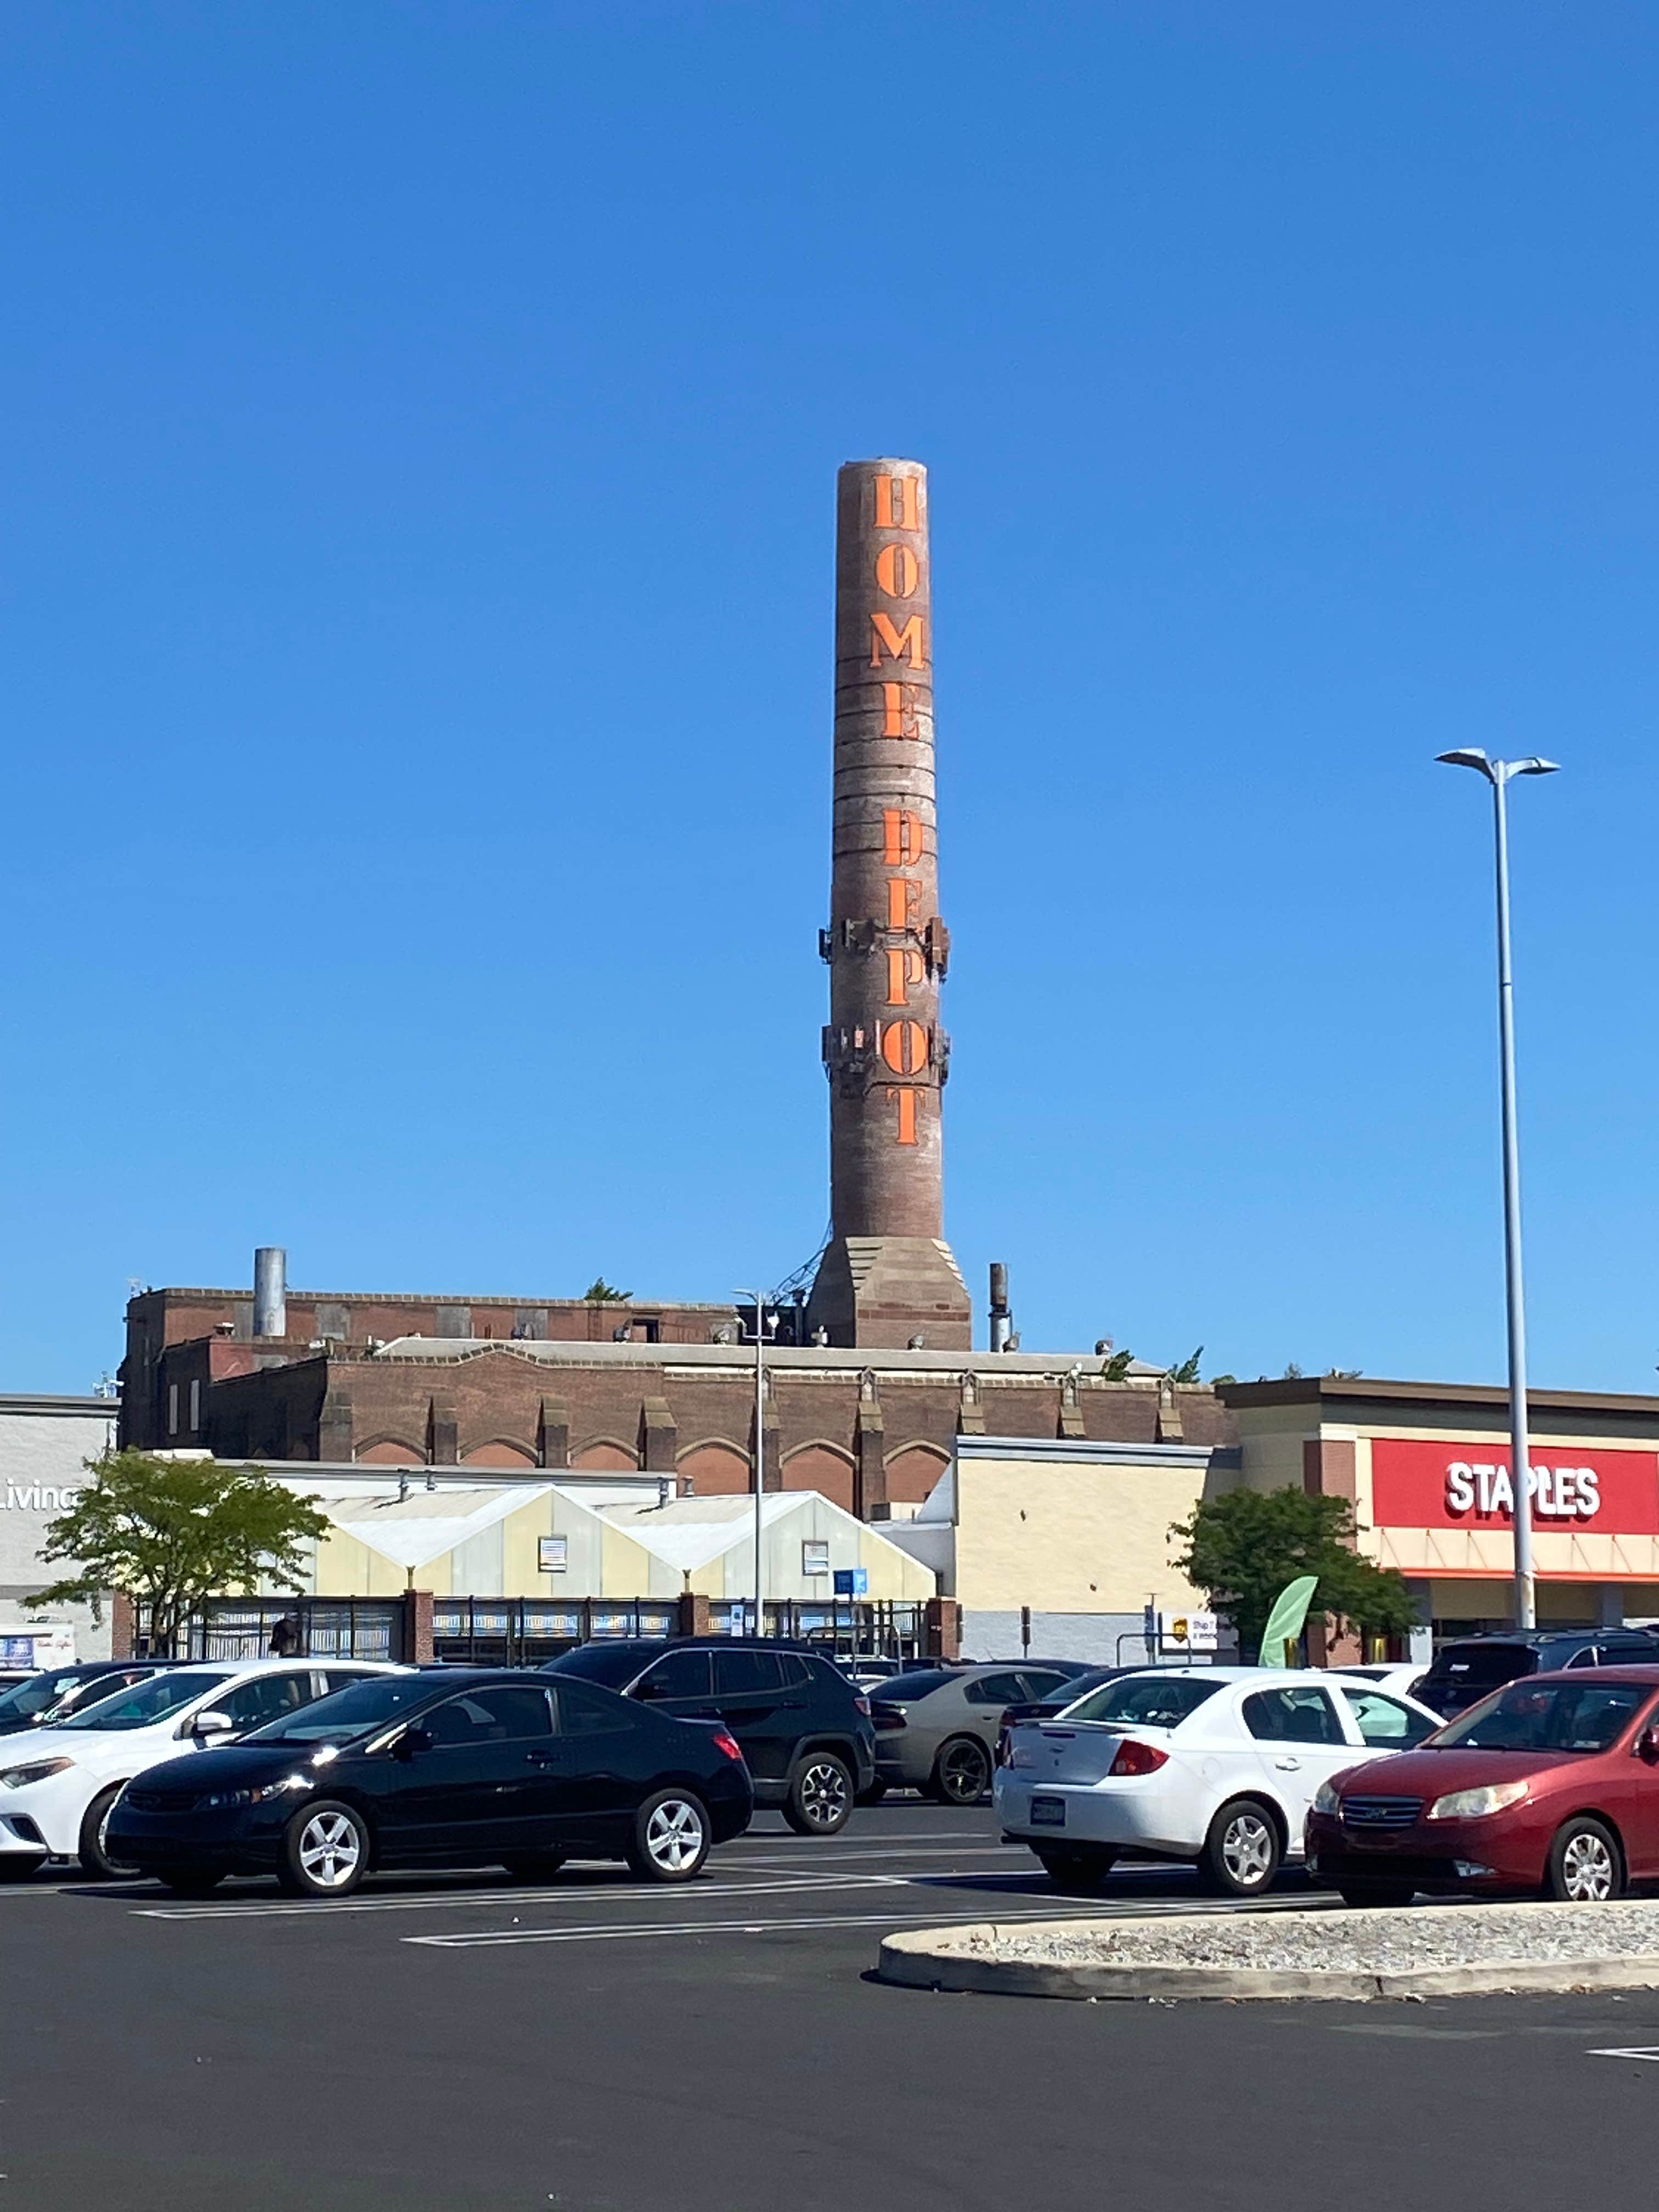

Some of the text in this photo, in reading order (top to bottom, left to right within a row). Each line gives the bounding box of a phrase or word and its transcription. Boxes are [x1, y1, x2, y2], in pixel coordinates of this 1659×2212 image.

[869, 473, 926, 740] HOME
[882, 809, 928, 1146] DEPOT
[0, 1478, 80, 1516] iving
